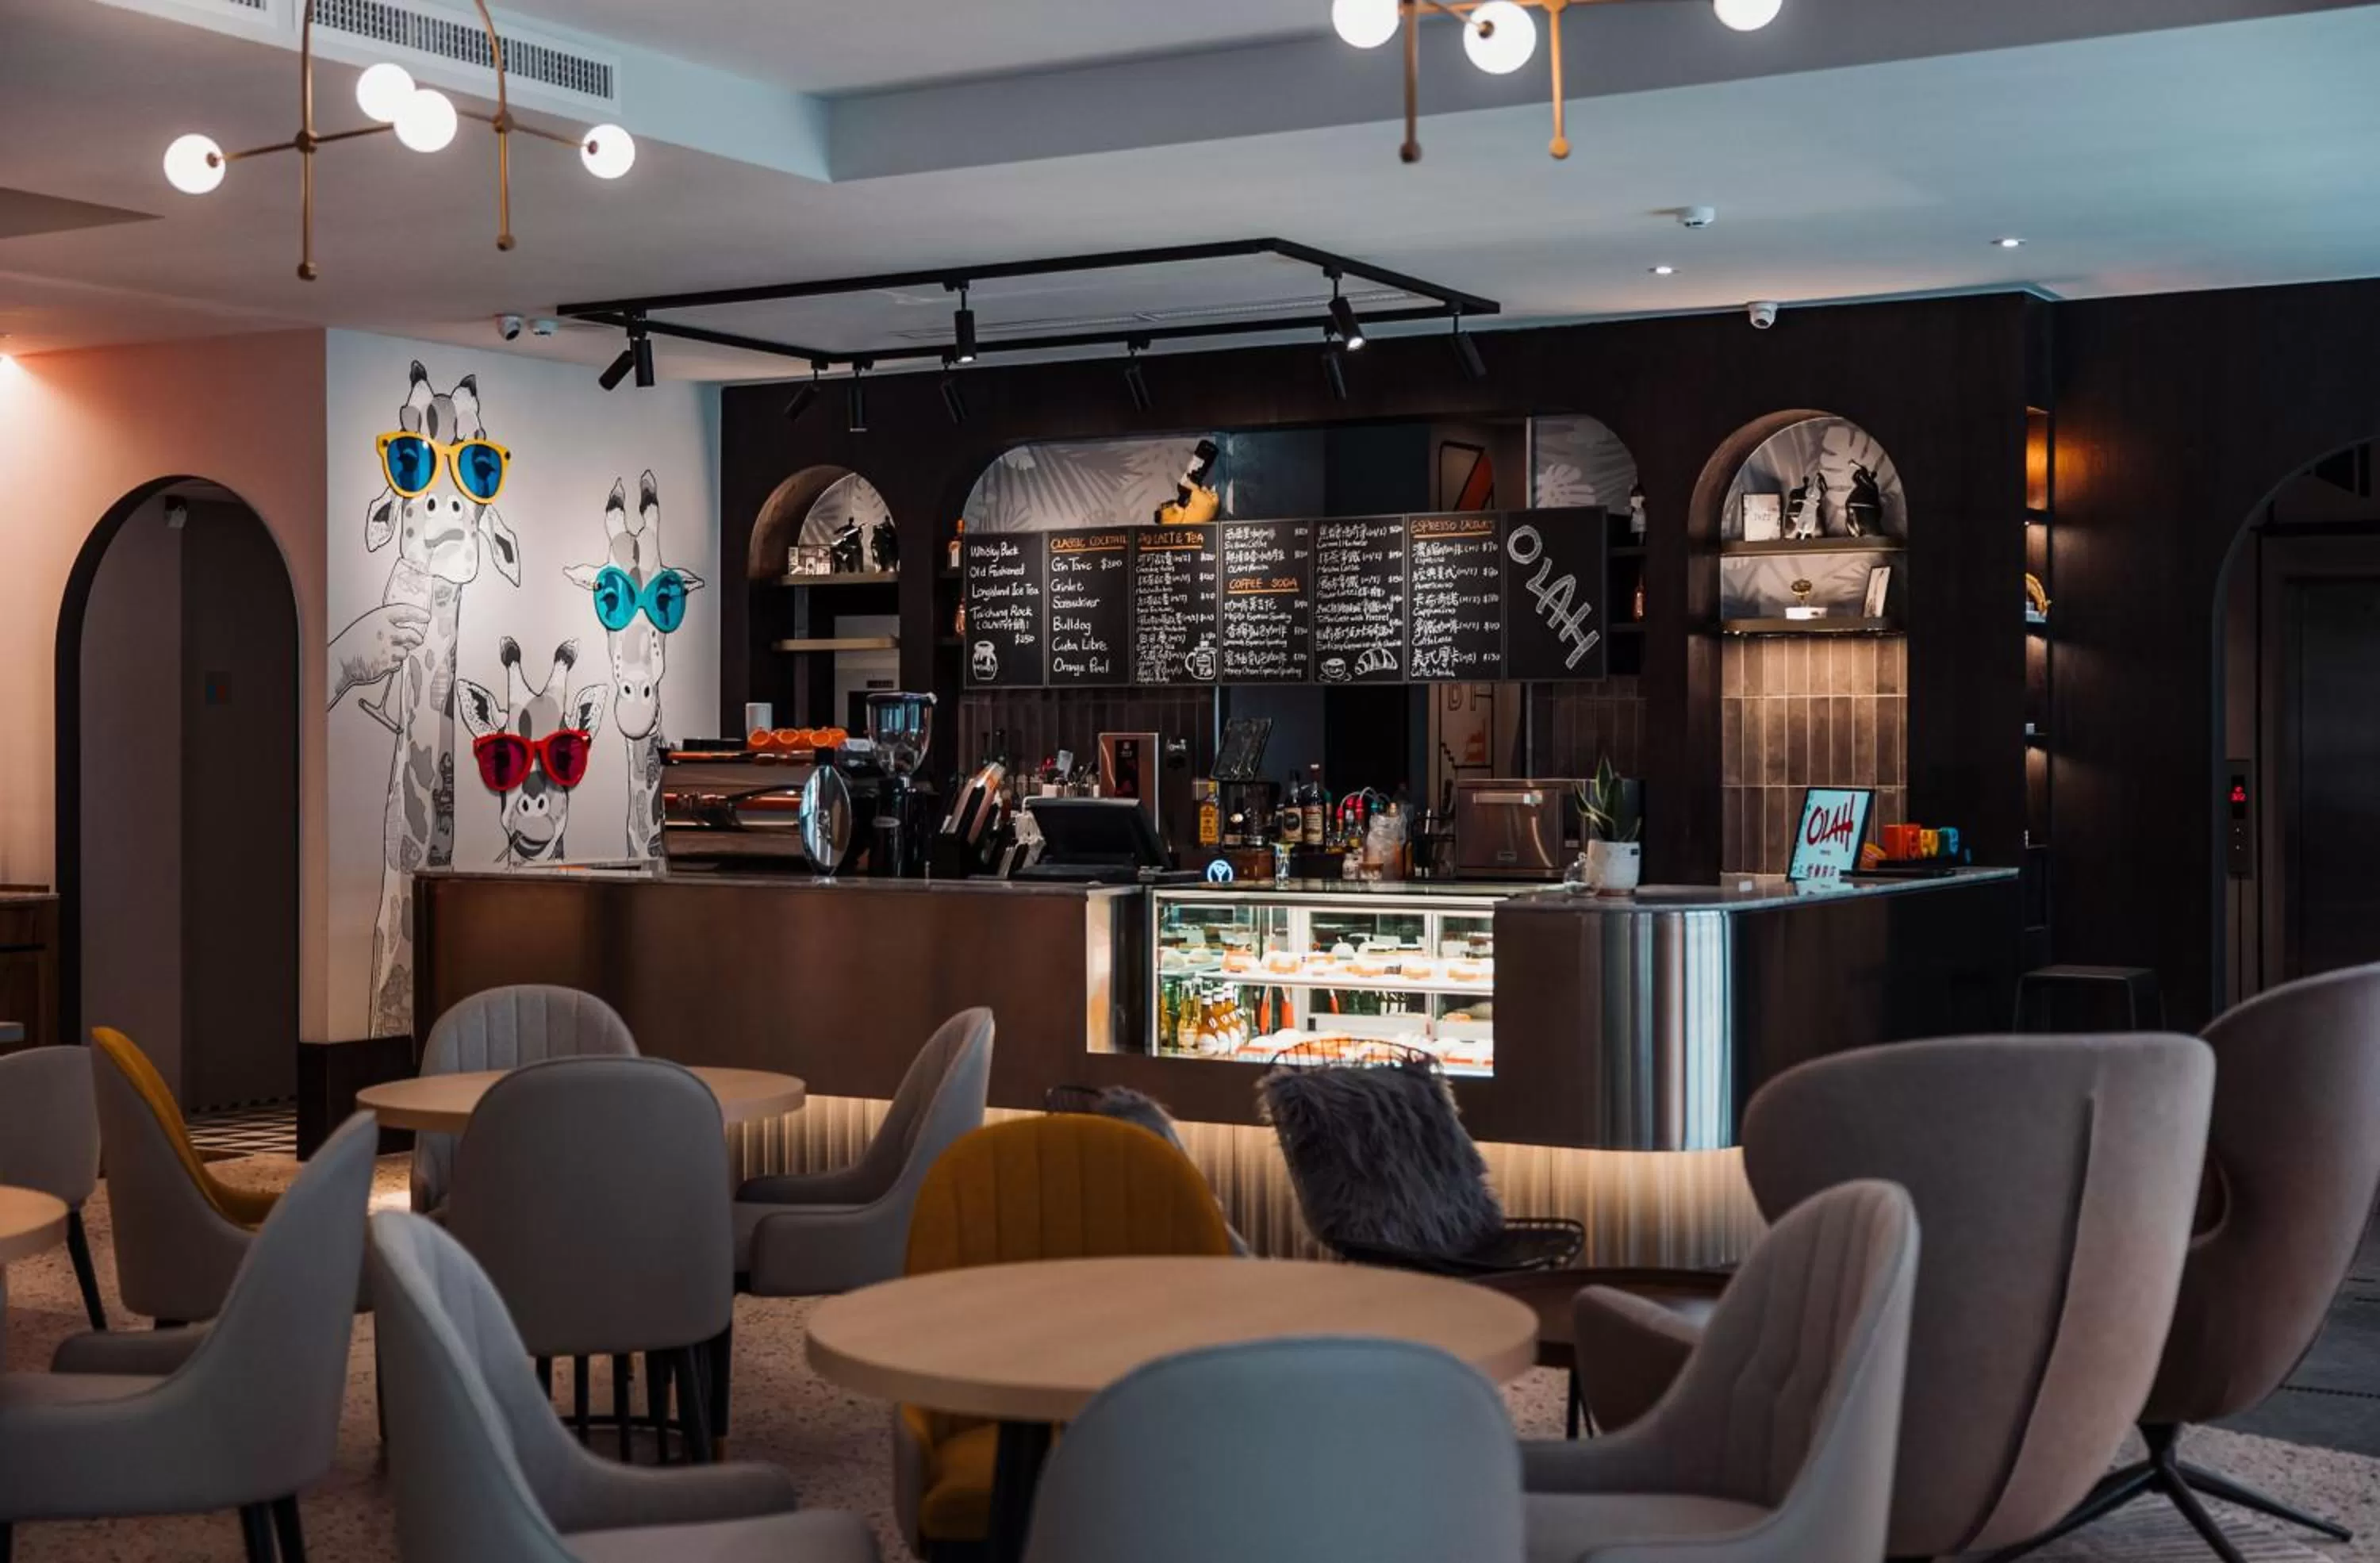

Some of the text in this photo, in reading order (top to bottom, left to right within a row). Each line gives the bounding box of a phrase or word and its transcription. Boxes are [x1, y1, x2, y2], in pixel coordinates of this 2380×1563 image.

[1411, 520, 1457, 533] ESPRESSO
[1050, 534, 1127, 549] CLASSIC COCKTAIL
[1185, 532, 1204, 543] TEA
[969, 563, 1025, 578] Old Fashioned
[1051, 557, 1069, 571] Gin
[1069, 557, 1092, 571] Tonic
[1012, 582, 1023, 596] Ice
[1024, 583, 1039, 595] Tea
[1229, 578, 1297, 589] COFFEE SODA
[1507, 525, 1600, 670] OLAH
[1010, 605, 1033, 616] Rock
[1054, 616, 1091, 636] Bulldog
[1015, 633, 1035, 646] $250
[1052, 636, 1107, 651] Cuba Libre
[1054, 657, 1085, 676] Orange
[1806, 793, 1856, 853] OLAH
